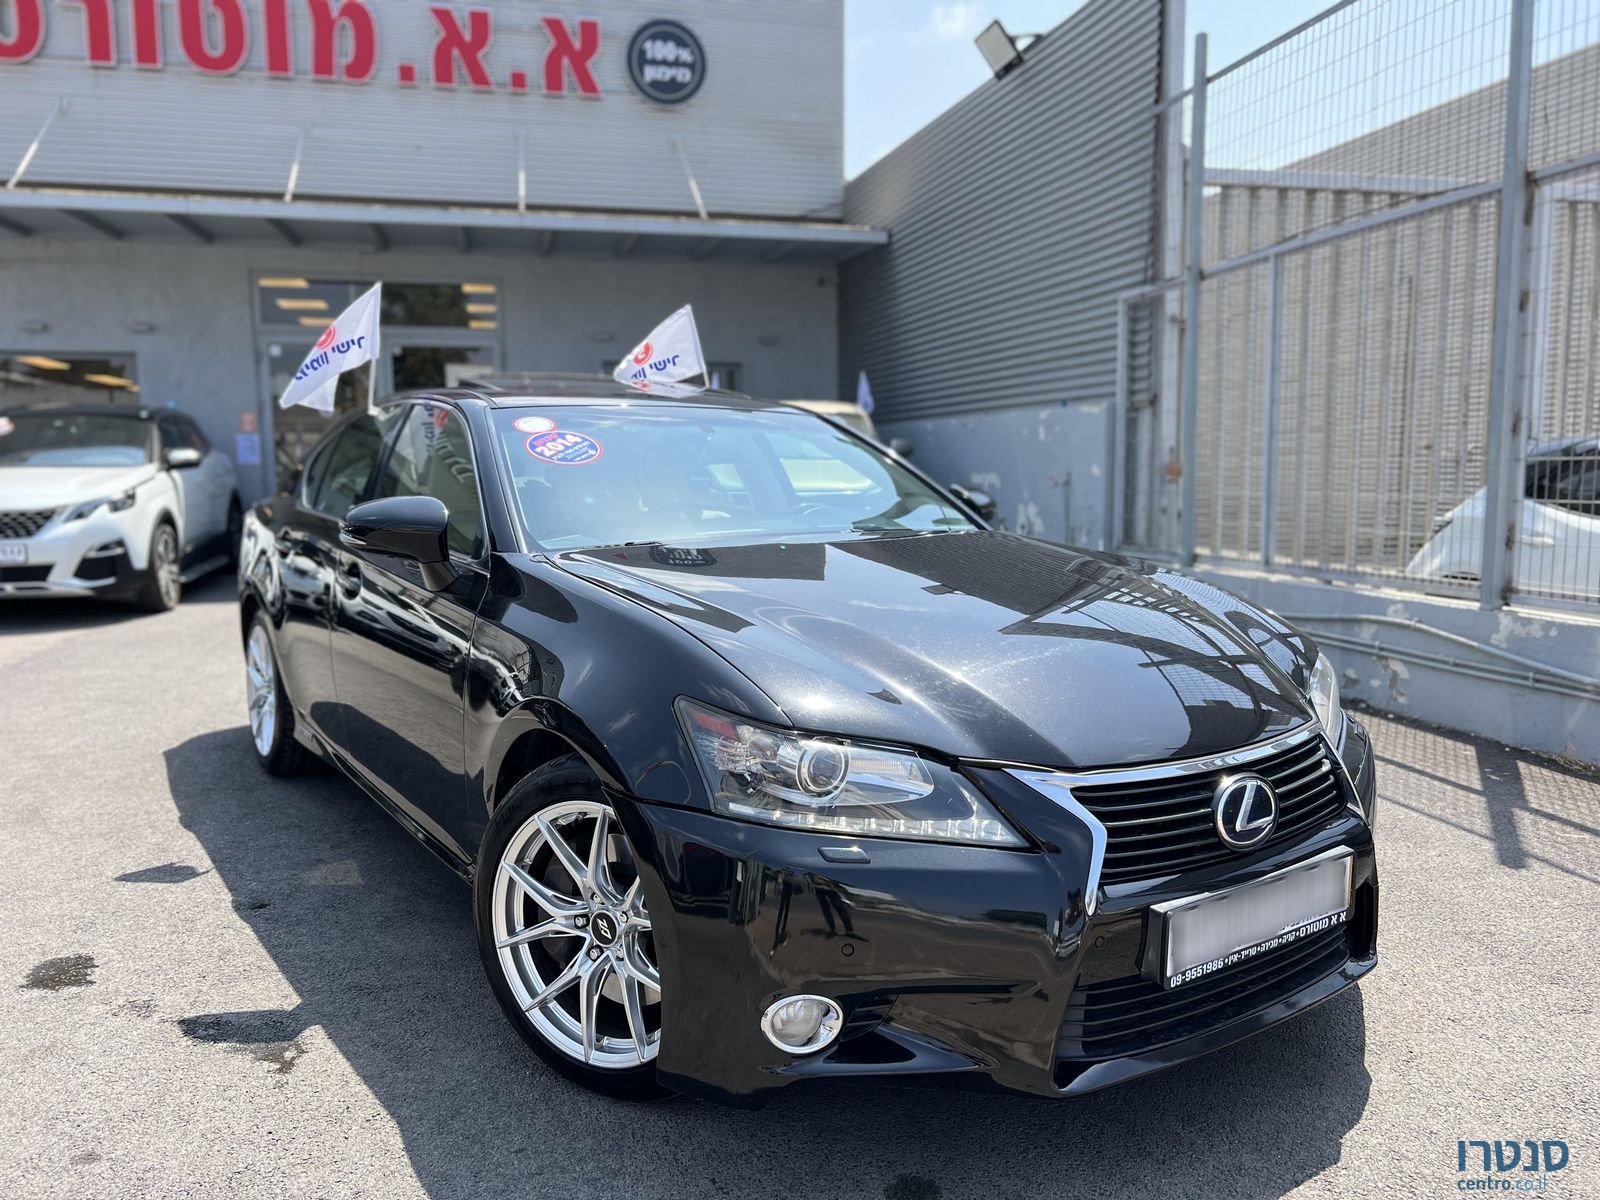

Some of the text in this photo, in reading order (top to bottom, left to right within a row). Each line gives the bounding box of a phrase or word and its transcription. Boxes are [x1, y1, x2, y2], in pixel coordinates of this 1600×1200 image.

[642, 39, 694, 63] 100%
[535, 434, 582, 457] 2014
[1299, 917, 1329, 937] מוטורס
[1170, 958, 1224, 988] 09-9551986
